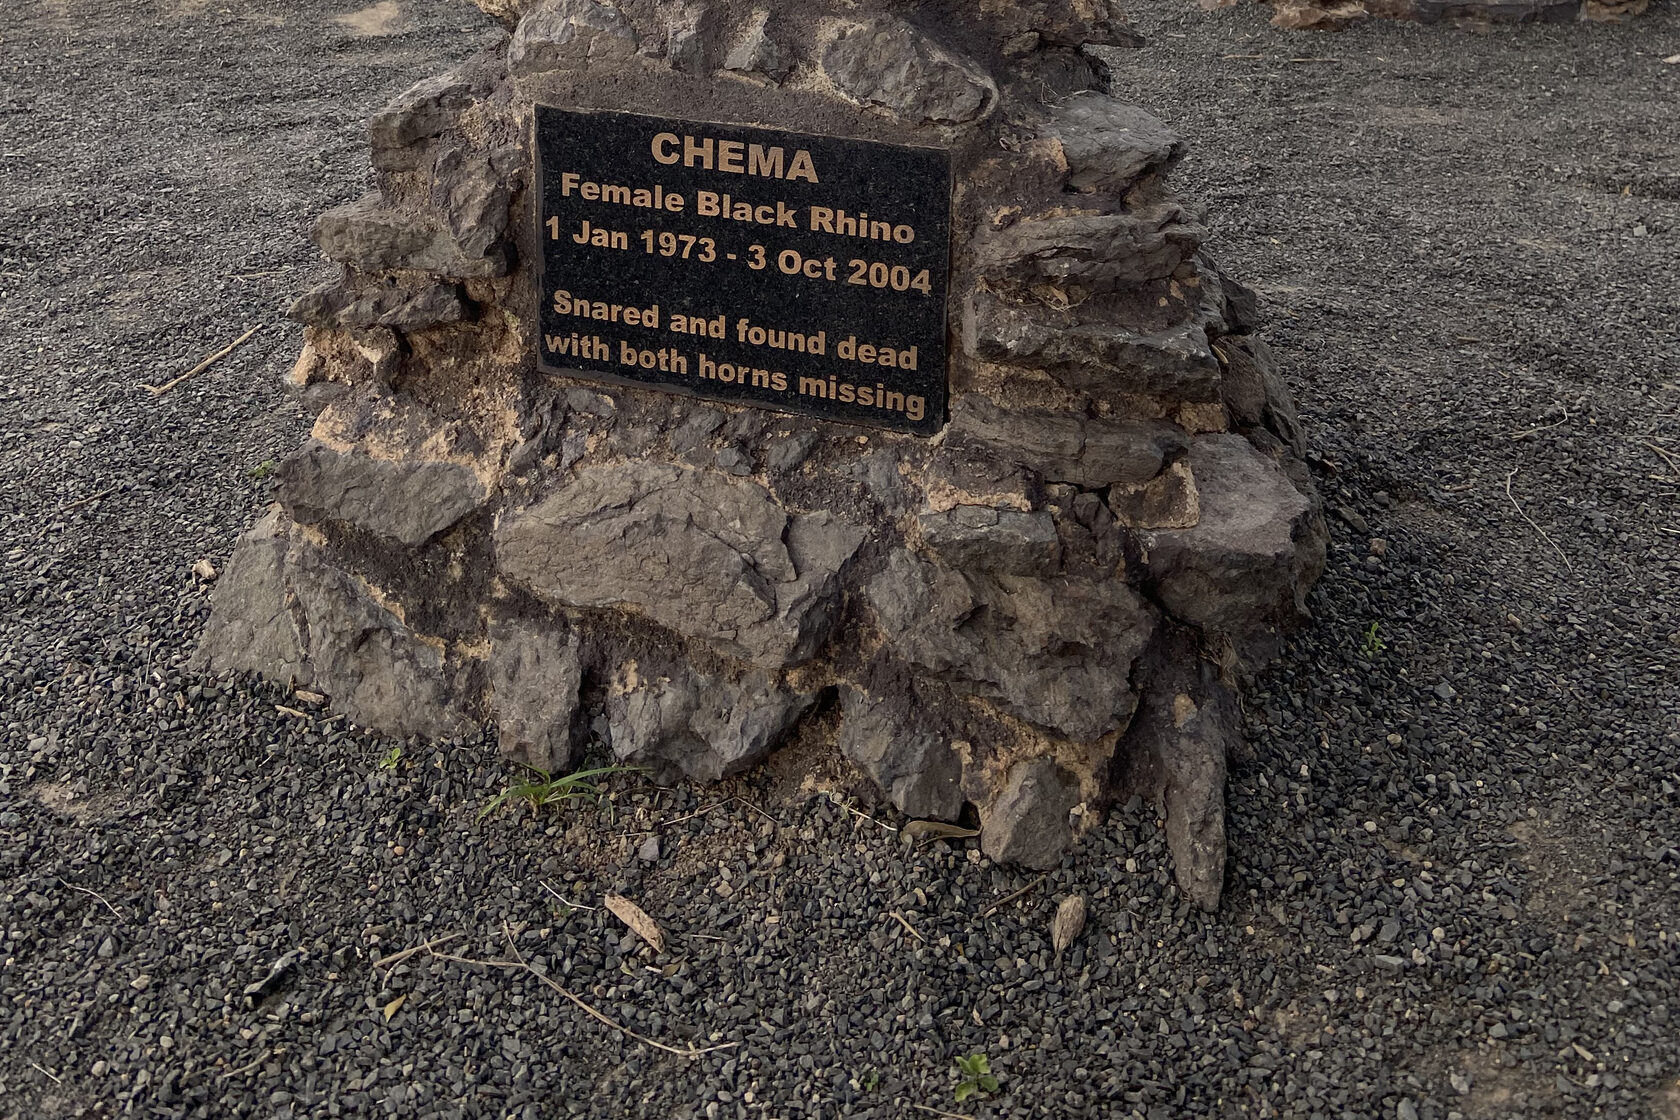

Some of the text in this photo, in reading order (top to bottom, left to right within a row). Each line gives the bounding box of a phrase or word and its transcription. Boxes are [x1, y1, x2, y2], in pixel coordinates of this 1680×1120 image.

[651, 133, 819, 183] CHEMA
[562, 173, 914, 244] Female Black Rhino
[546, 216, 559, 240] 1
[573, 220, 628, 250] Jan
[641, 230, 716, 263] 1973
[748, 244, 766, 269] 3
[779, 249, 836, 281] Oct
[848, 259, 931, 295] 2004
[554, 289, 918, 371] Snared and found dead
[544, 332, 925, 420] with both horns missing
